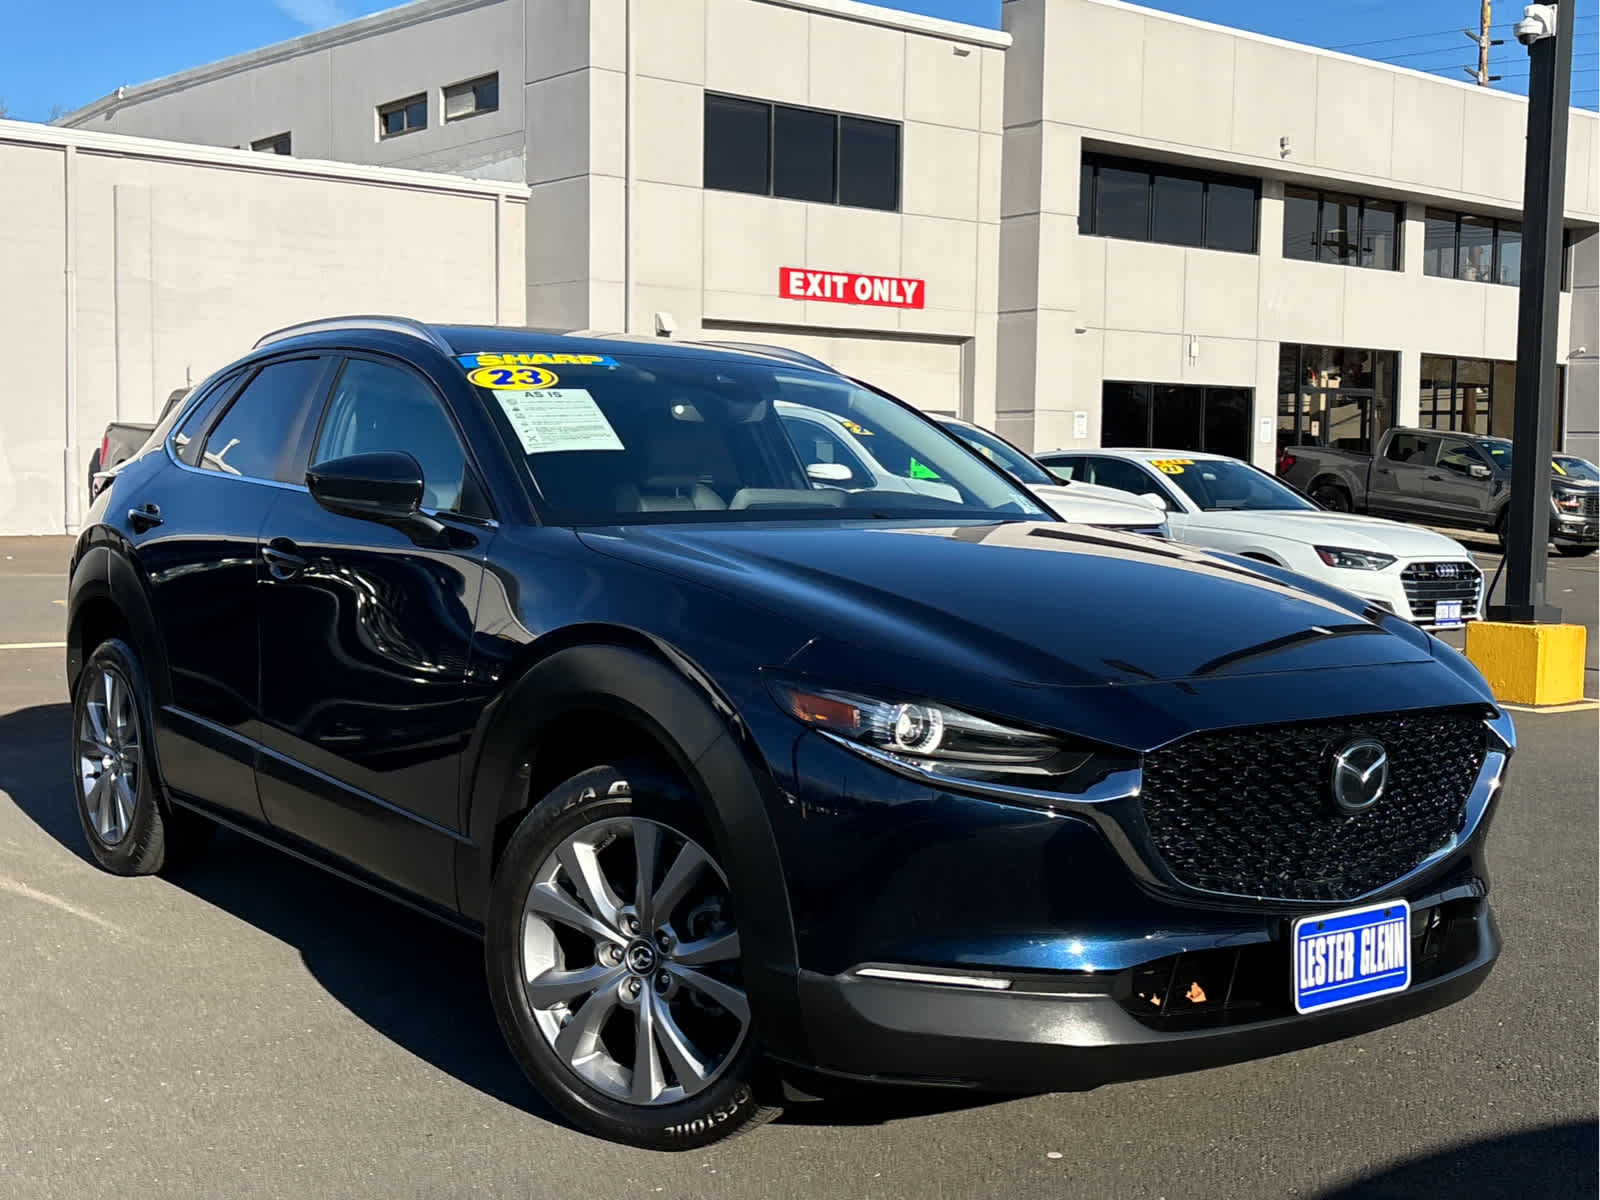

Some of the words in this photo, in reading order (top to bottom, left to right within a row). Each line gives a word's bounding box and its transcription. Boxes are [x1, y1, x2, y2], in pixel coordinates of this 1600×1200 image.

[789, 271, 848, 298] EXIT
[854, 276, 917, 304] ONLY
[476, 354, 604, 366] SHARP
[488, 368, 543, 385] 23
[1300, 931, 1355, 990] LESTER
[1360, 921, 1405, 976] GLENN
